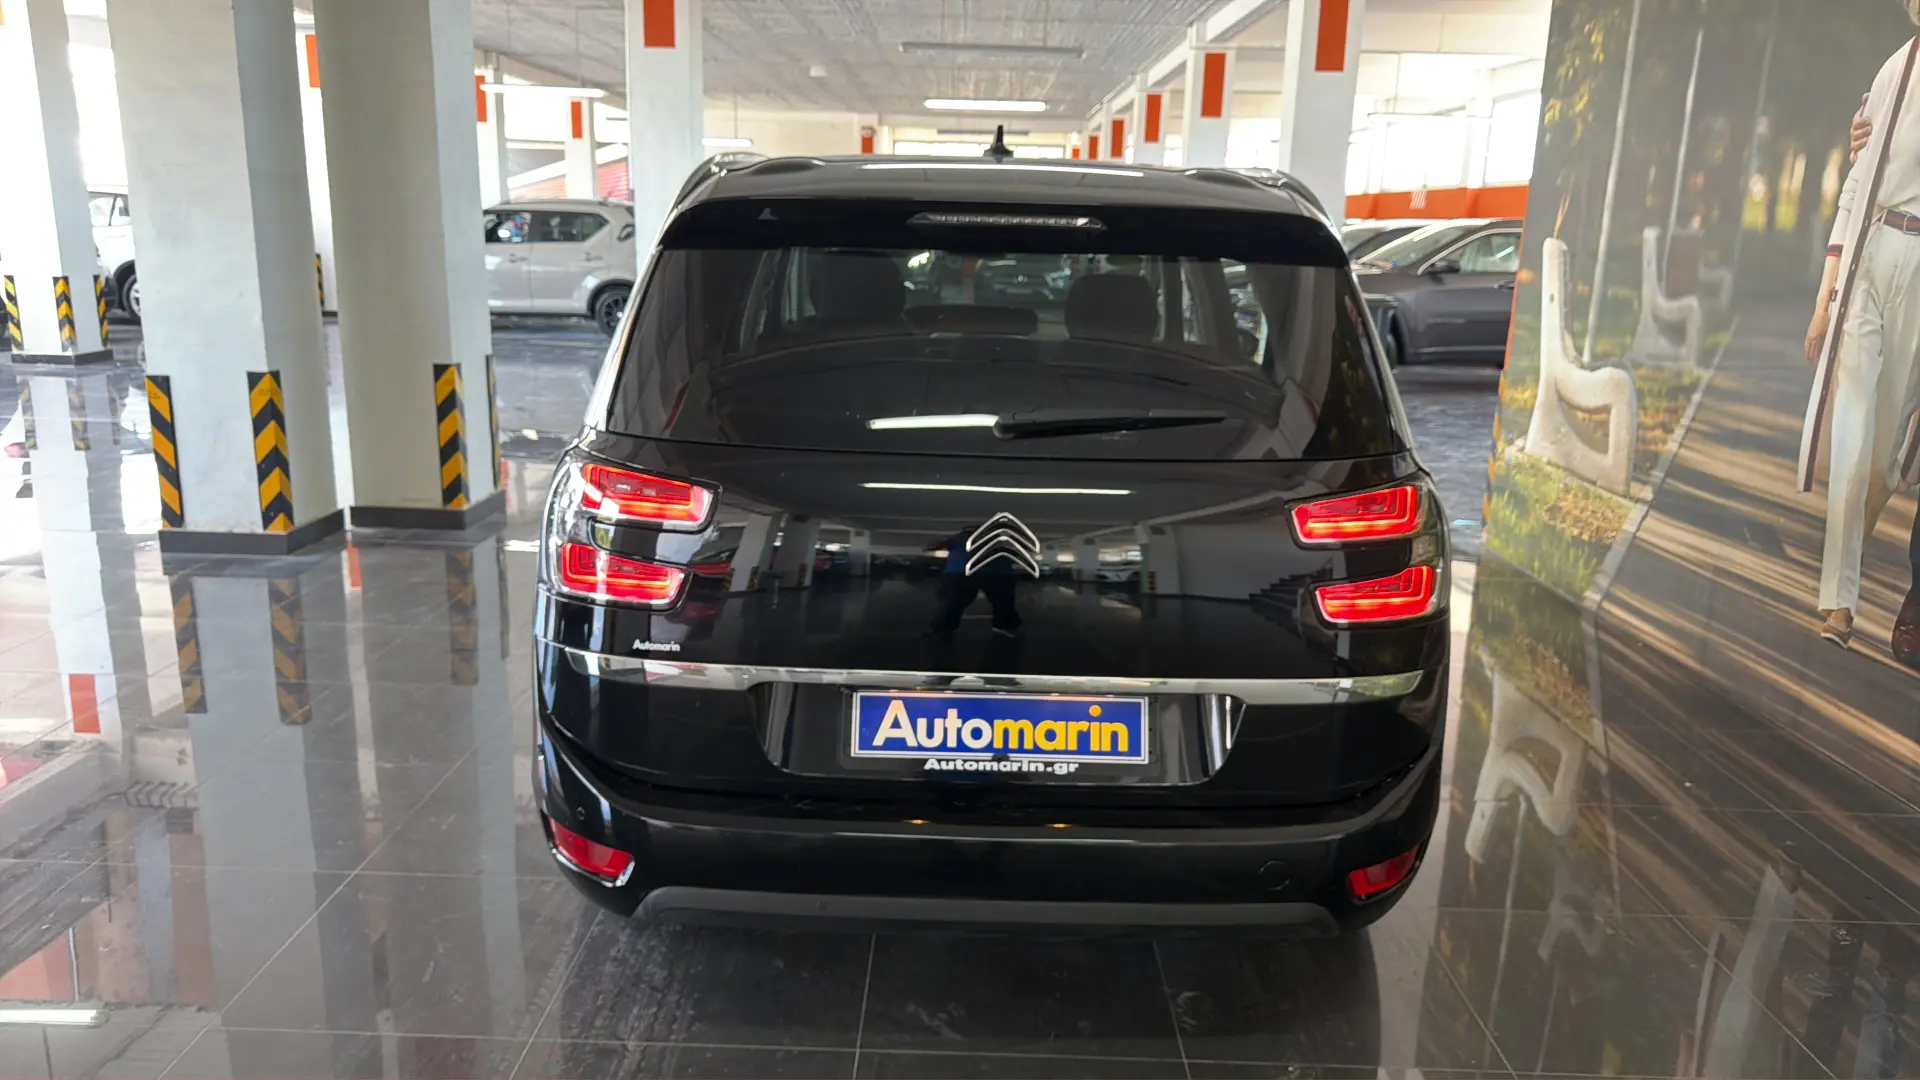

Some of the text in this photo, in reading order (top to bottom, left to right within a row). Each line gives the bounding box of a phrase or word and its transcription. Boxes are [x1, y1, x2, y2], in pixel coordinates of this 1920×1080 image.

[632, 638, 681, 652] Automarin
[872, 700, 1129, 752] Automarin
[924, 758, 1079, 775] Automarin.gr
